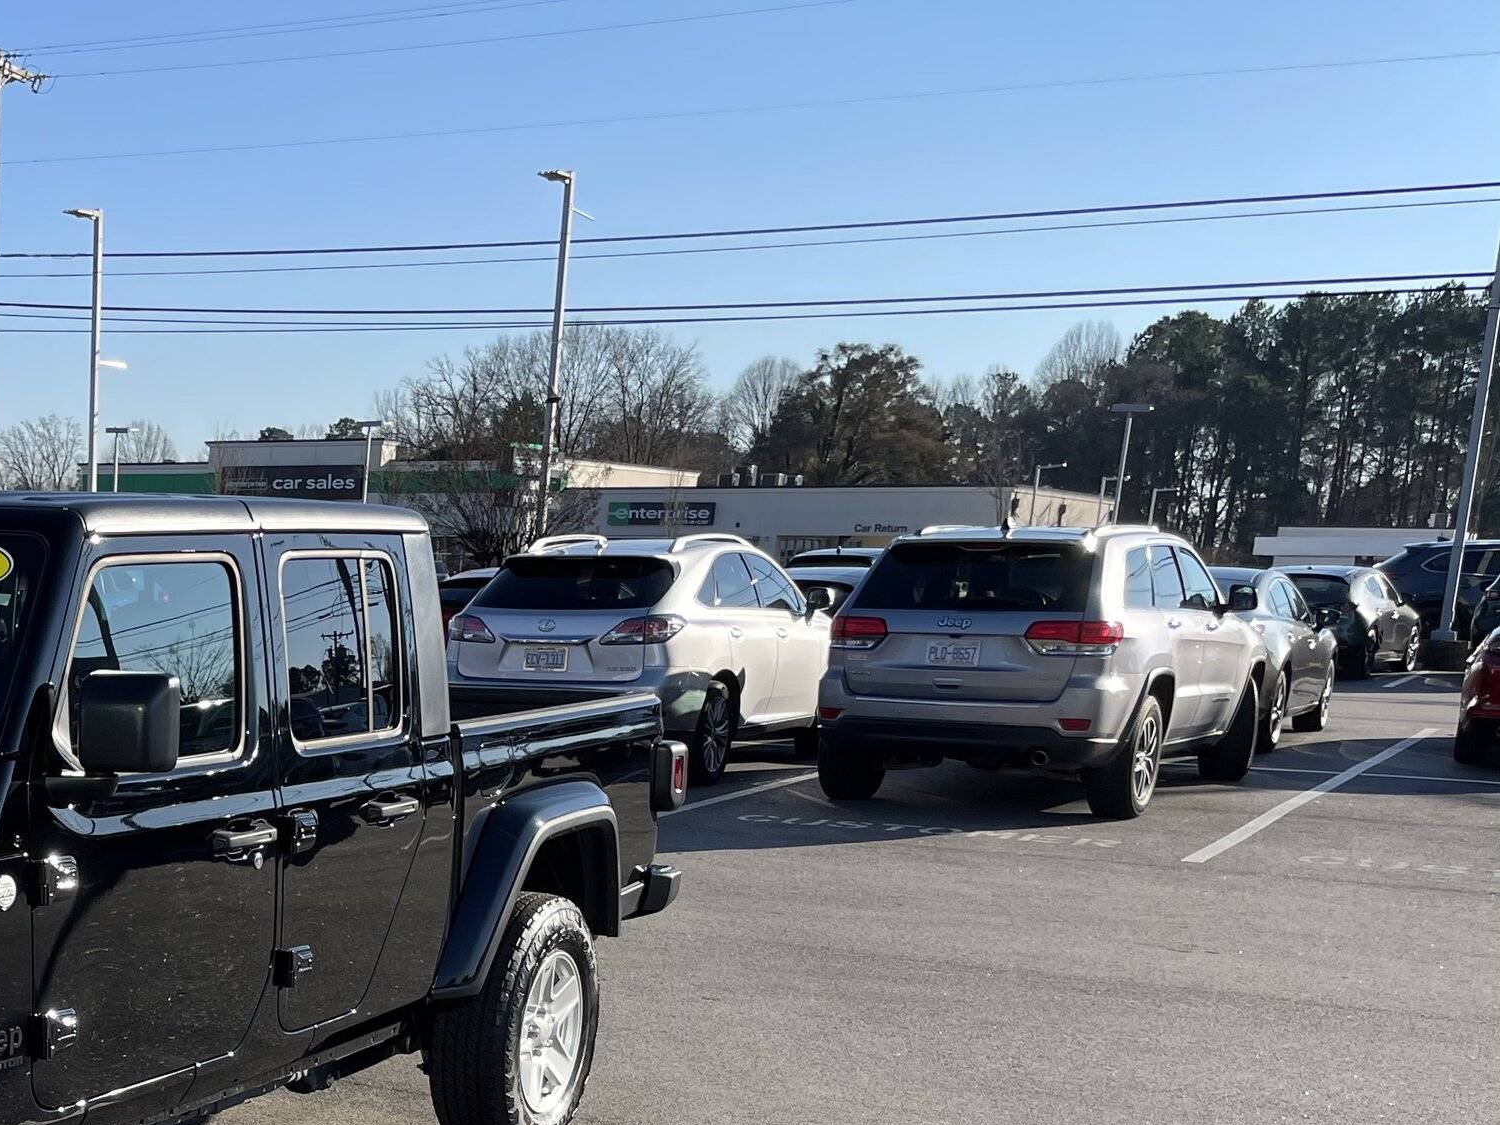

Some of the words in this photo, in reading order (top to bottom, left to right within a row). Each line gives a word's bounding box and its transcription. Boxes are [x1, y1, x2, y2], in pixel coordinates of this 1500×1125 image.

[272, 478, 302, 490] car
[306, 473, 355, 490] sales
[854, 523, 872, 532] Car
[874, 523, 908, 532] Return
[937, 616, 972, 630] Jeep
